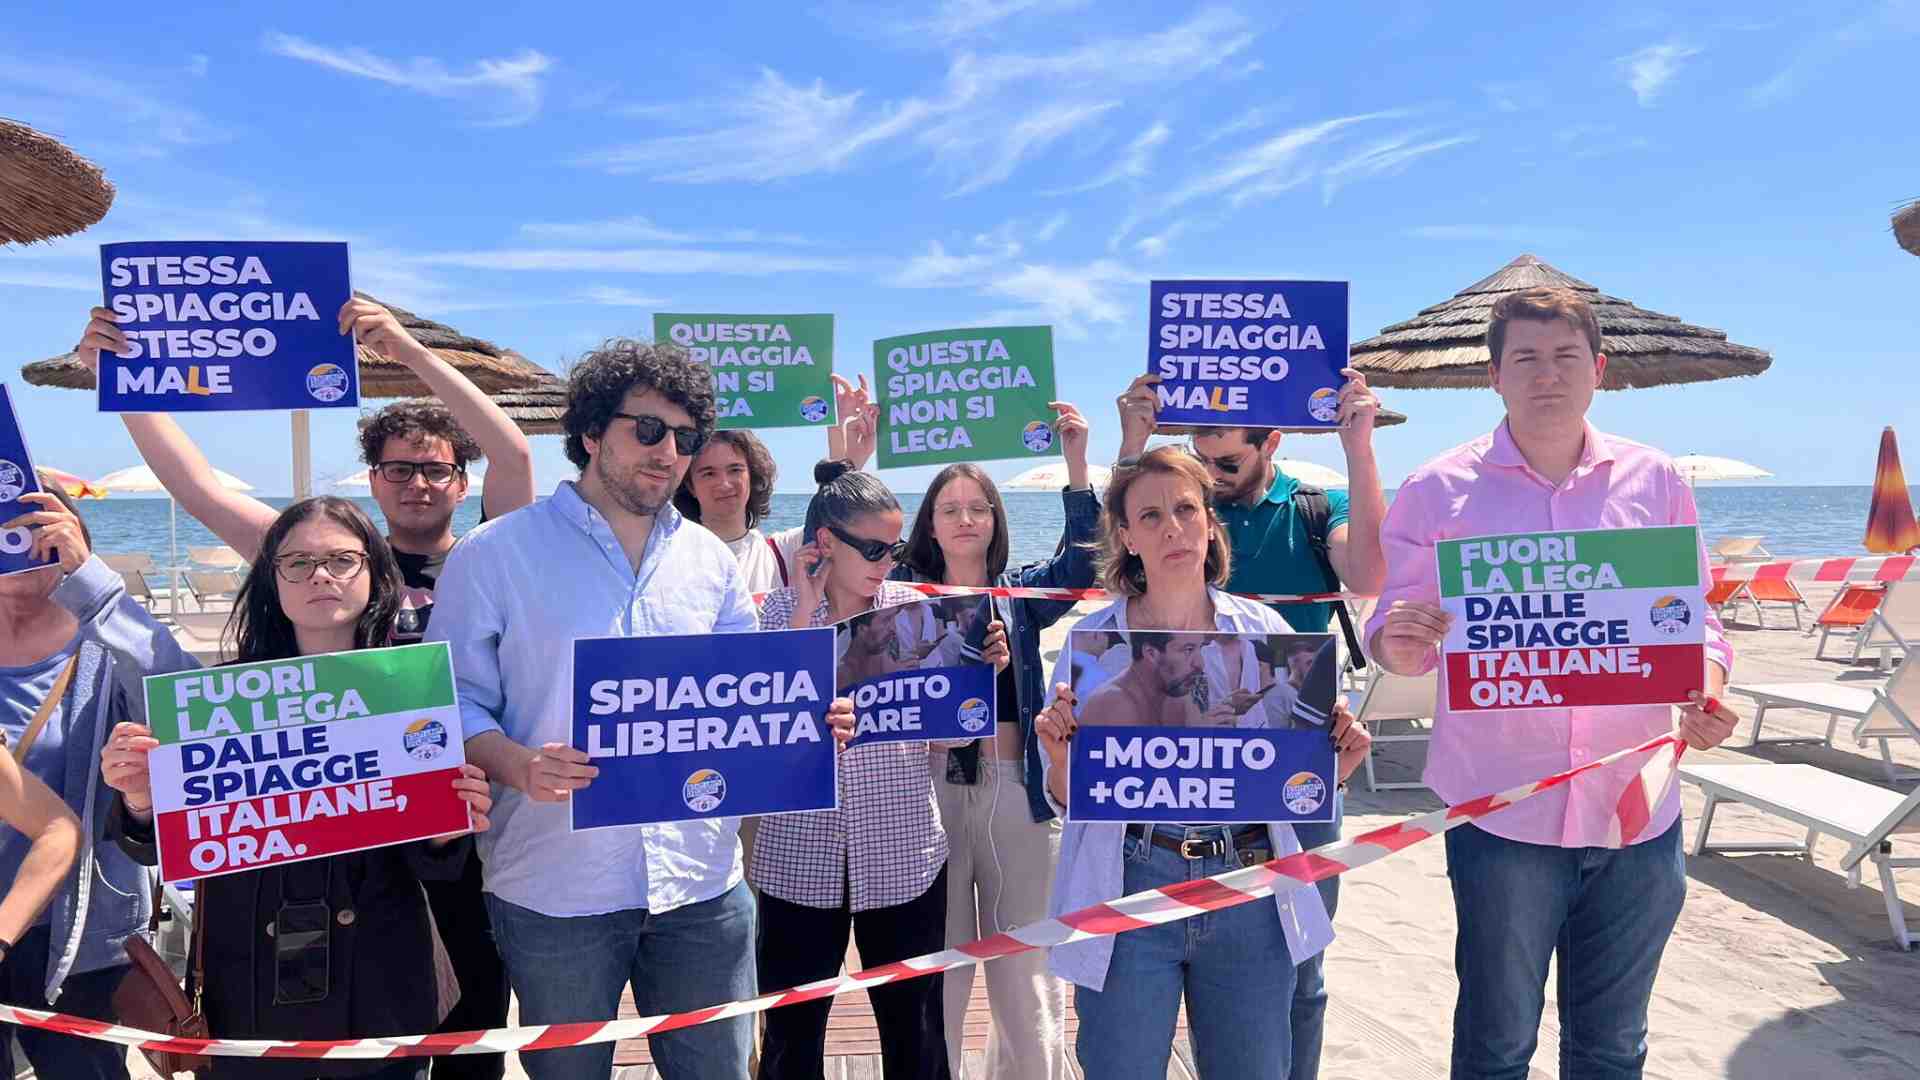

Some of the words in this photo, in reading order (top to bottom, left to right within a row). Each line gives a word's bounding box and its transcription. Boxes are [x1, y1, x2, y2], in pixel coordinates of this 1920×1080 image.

[111, 256, 272, 287] STESSA
[112, 292, 320, 323] SPIAGGIA
[1161, 293, 1292, 320] STESSA
[116, 329, 278, 359] STESSO
[670, 323, 792, 347] QUESTA
[1159, 324, 1326, 351] SPIAGGIA
[682, 346, 815, 367] PIAGGIA
[888, 339, 1010, 372] QUESTA
[1159, 355, 1289, 381] STESSO
[117, 365, 233, 396] MALE
[748, 371, 775, 392] SI
[888, 367, 1036, 398] SPIAGGIA
[715, 397, 754, 418] GA
[889, 398, 959, 427] NON
[965, 396, 995, 420] SI
[1158, 386, 1249, 412] MALE
[891, 426, 973, 454] LEGA
[1460, 536, 1577, 568] FUORI
[1462, 566, 1514, 594] LA
[1522, 562, 1624, 592] LEGA
[1465, 593, 1586, 623] DALLE
[1466, 619, 1630, 651] SPIAGGE
[1469, 648, 1653, 679] ITALIANE,
[175, 662, 316, 708] FUORI
[589, 670, 820, 715] SPIAGGIA
[850, 674, 951, 708] OJITO
[1470, 680, 1564, 707] ORA.
[177, 705, 239, 740] LA
[250, 689, 370, 728] LEGA
[855, 706, 922, 736] ARE
[181, 725, 329, 774] DALLE
[588, 710, 820, 758] LIBERATA
[1089, 736, 1276, 770] -MOJITO
[184, 750, 381, 806] SPIAGGE
[1089, 777, 1236, 809] +GARE
[187, 780, 407, 841] ITALIANE,
[190, 831, 307, 872] ORA.
